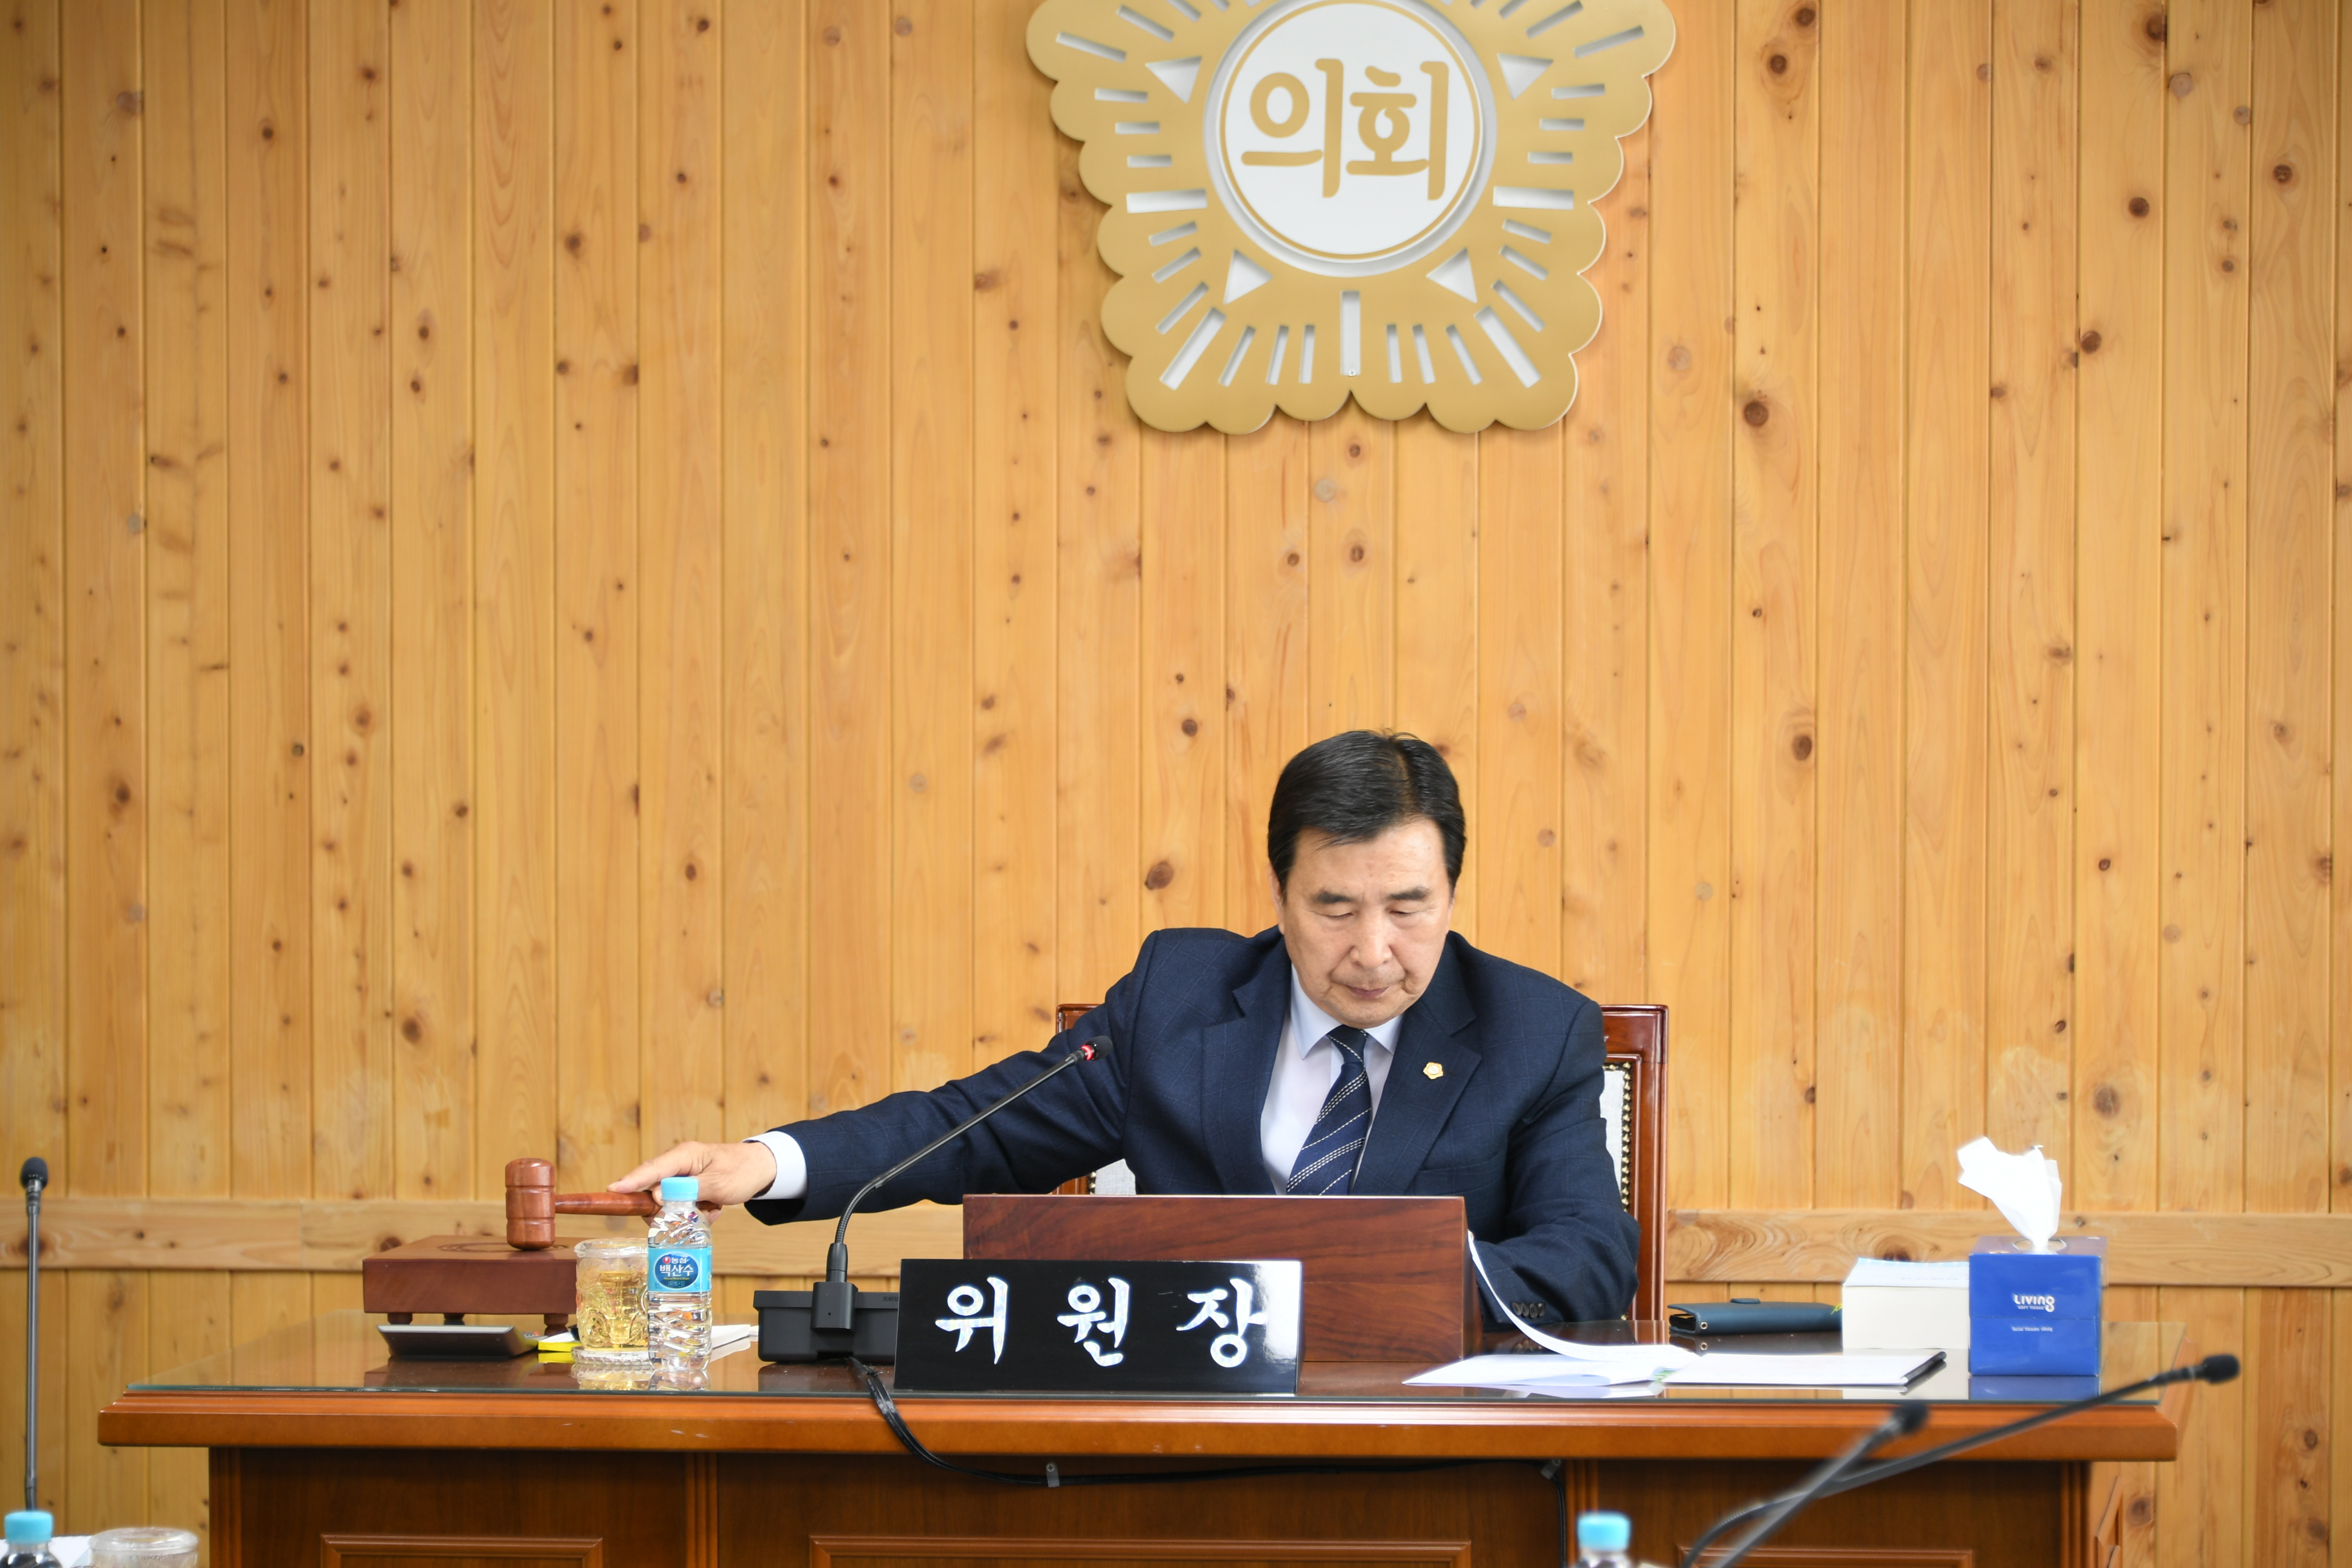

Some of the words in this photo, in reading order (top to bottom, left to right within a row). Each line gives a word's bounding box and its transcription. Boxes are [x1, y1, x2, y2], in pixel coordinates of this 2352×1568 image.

[1241, 58, 1449, 201] 의회
[659, 1264, 694, 1277] 백산수
[935, 1277, 1265, 1368] 위원장
